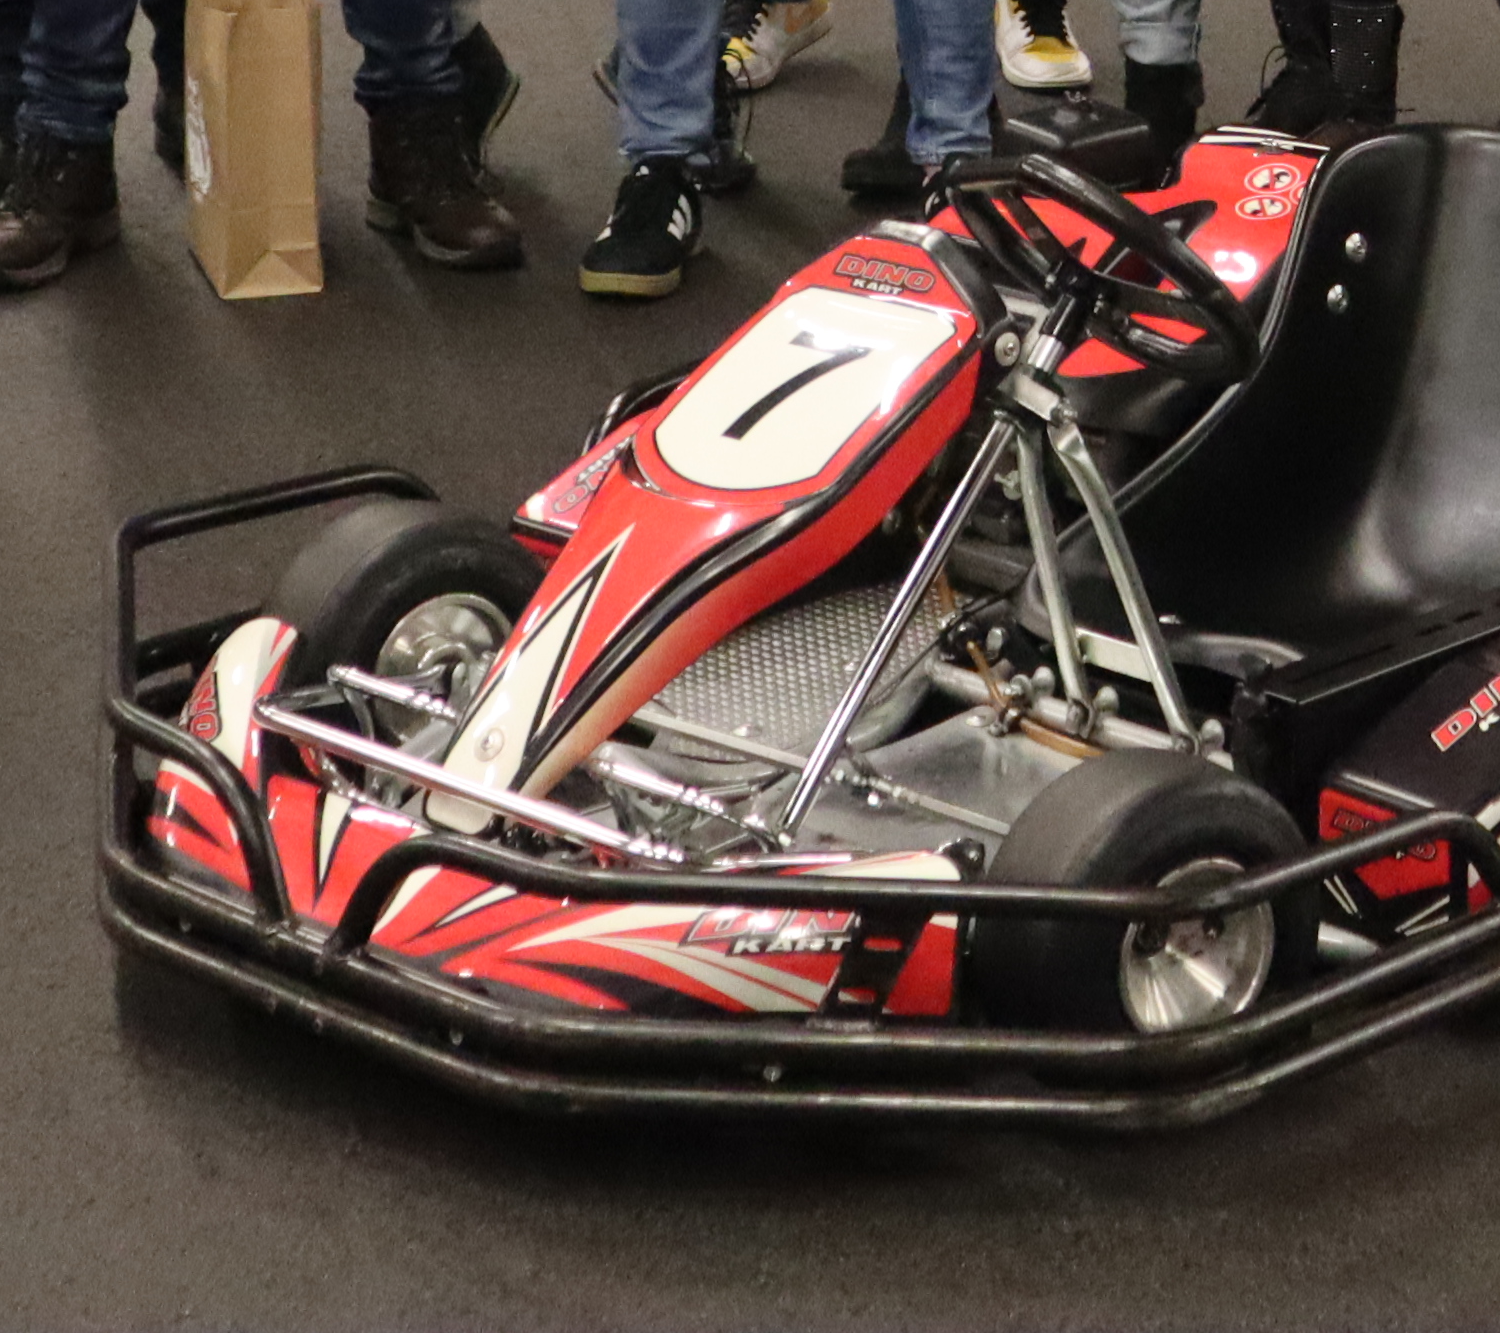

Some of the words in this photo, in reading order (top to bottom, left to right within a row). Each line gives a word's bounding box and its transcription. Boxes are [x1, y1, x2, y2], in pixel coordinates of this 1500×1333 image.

[834, 253, 937, 293] DINO
[852, 278, 903, 295] KART
[722, 330, 870, 441] 7
[731, 936, 852, 955] KART
